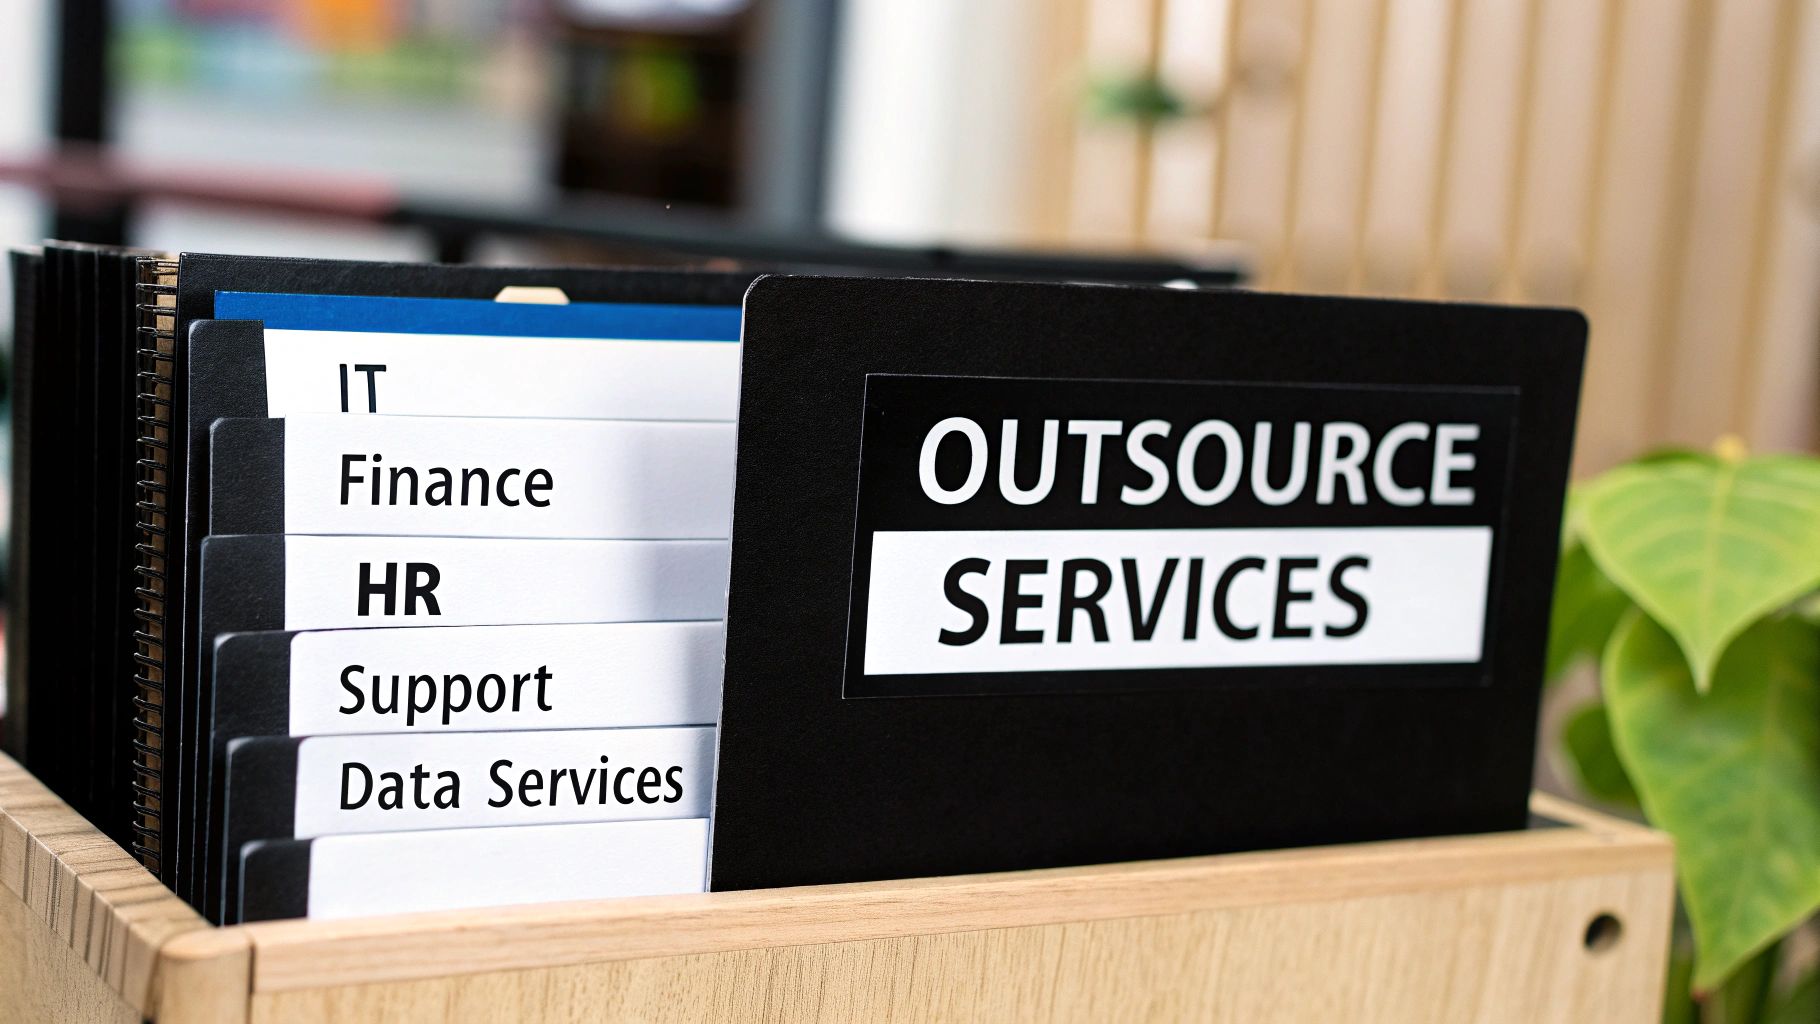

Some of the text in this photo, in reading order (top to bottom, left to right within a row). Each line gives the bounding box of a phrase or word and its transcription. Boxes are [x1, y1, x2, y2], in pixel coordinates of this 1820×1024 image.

[340, 363, 387, 413] IT
[340, 453, 554, 508] Finance
[918, 416, 1480, 506] OUTSOURCE
[357, 562, 443, 617] HR
[938, 555, 1371, 647] SERVICES
[339, 664, 553, 727] Support
[340, 754, 684, 811] Data Services
